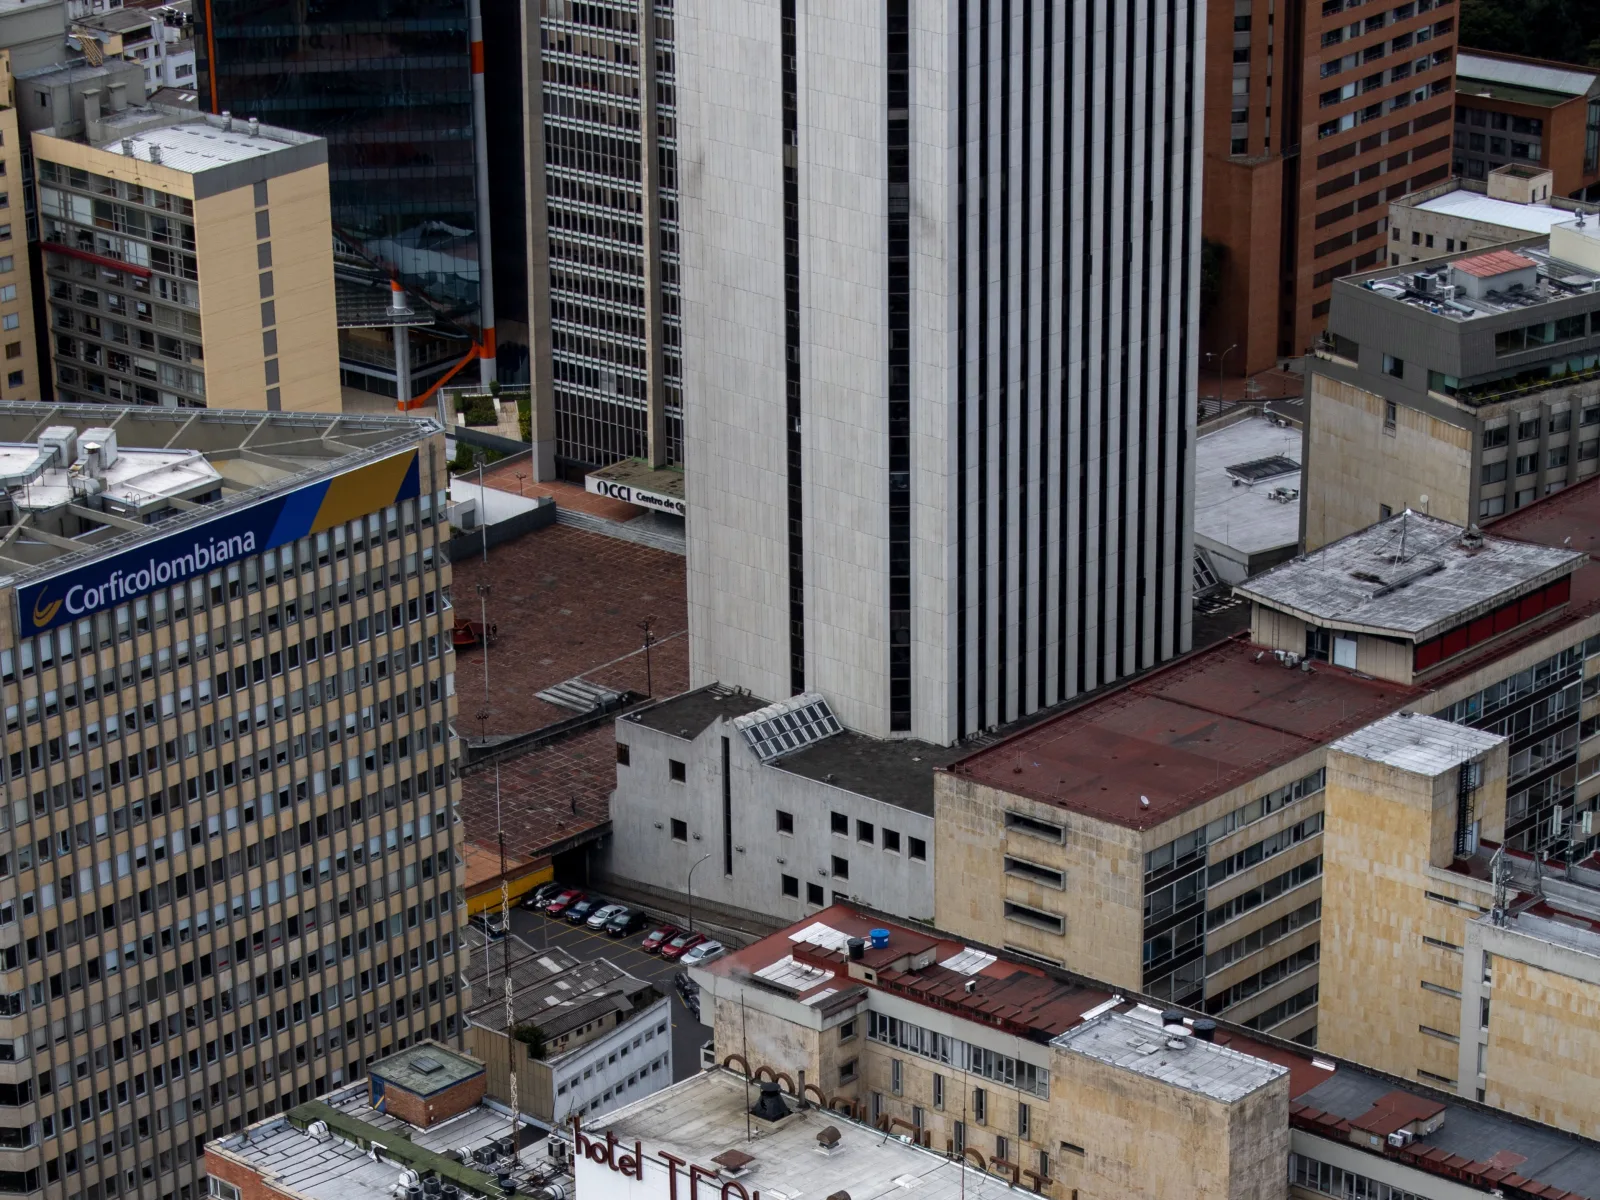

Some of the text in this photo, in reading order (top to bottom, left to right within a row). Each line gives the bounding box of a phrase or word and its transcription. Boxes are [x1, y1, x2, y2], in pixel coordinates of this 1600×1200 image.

[609, 484, 631, 502] CCI
[636, 492, 663, 506] Centro
[664, 498, 674, 509] de
[65, 530, 256, 614] Corficolombiana
[573, 1114, 643, 1181] hotel
